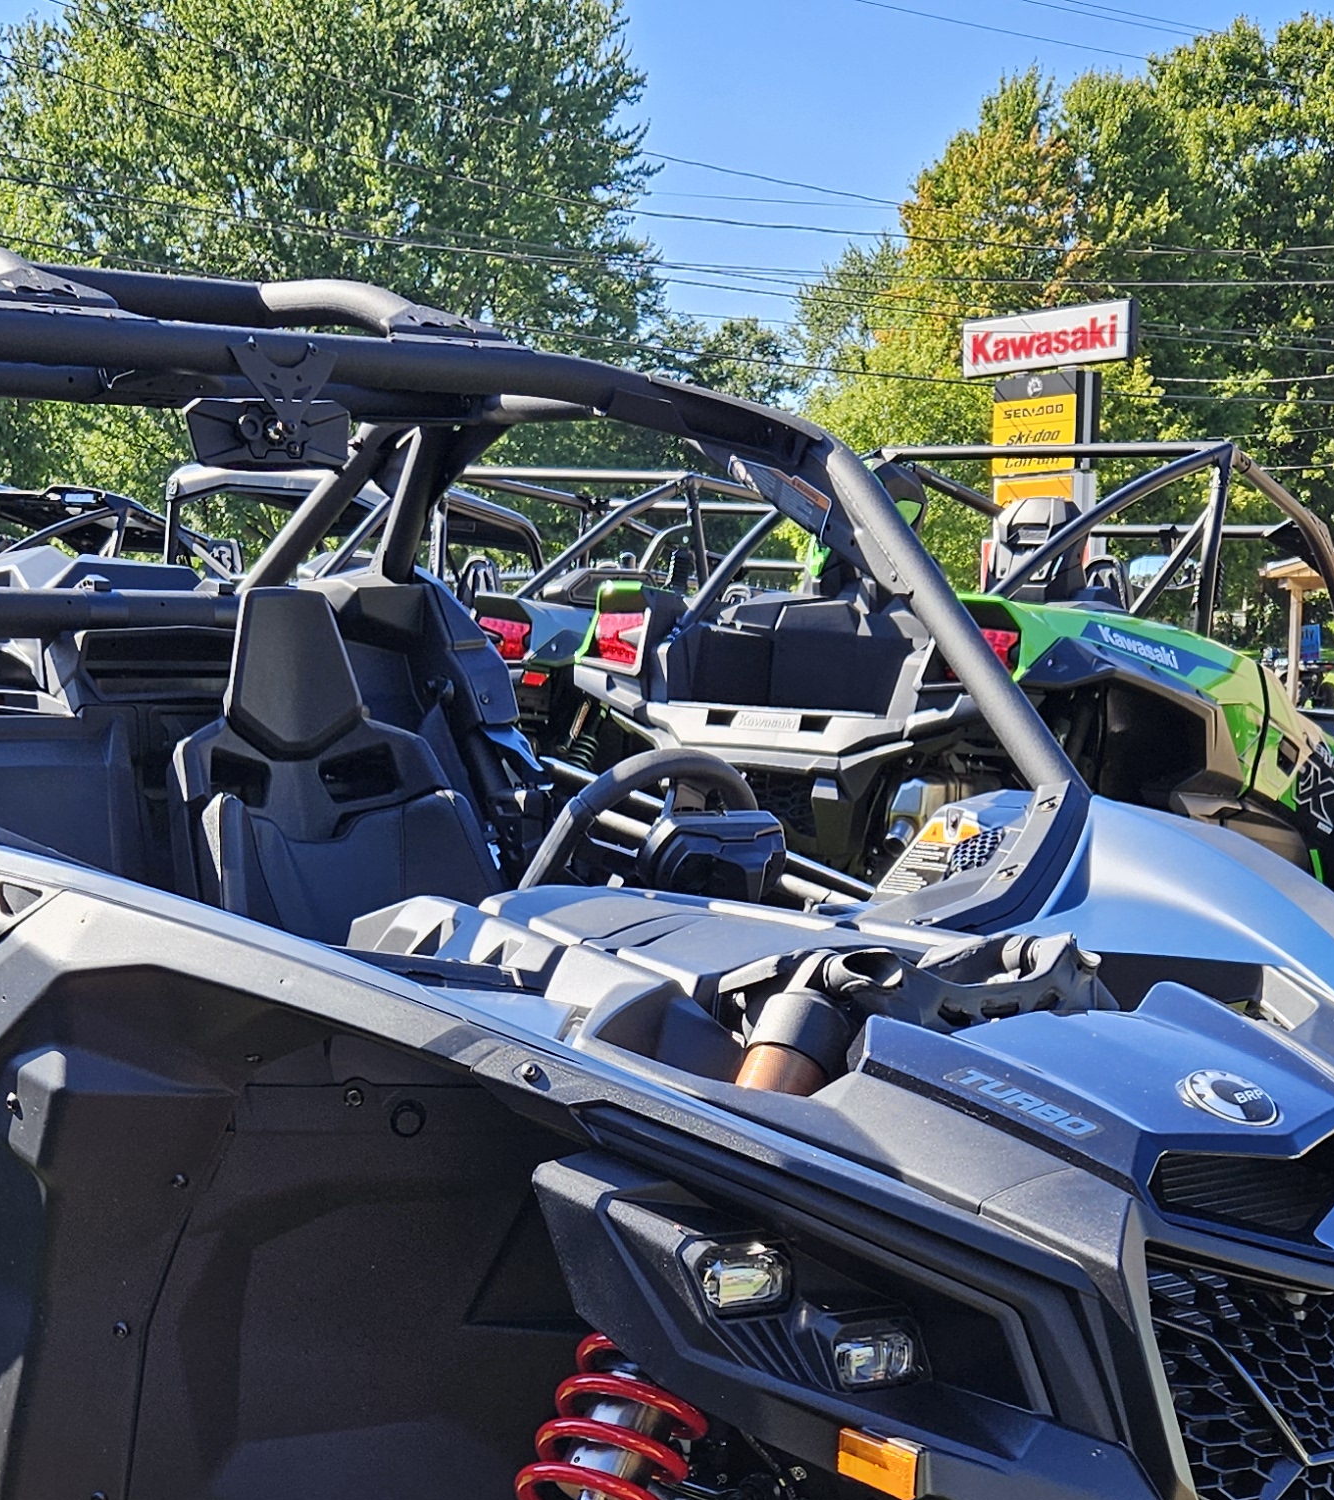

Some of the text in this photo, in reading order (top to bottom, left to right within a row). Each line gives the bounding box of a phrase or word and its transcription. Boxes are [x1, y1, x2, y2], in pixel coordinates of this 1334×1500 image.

[971, 315, 1117, 365] Kawasaki
[1097, 624, 1179, 670] Kawasaki
[738, 714, 798, 729] Kawasaki
[962, 1069, 1098, 1135] TURBO
[1234, 1088, 1264, 1104] BRP
